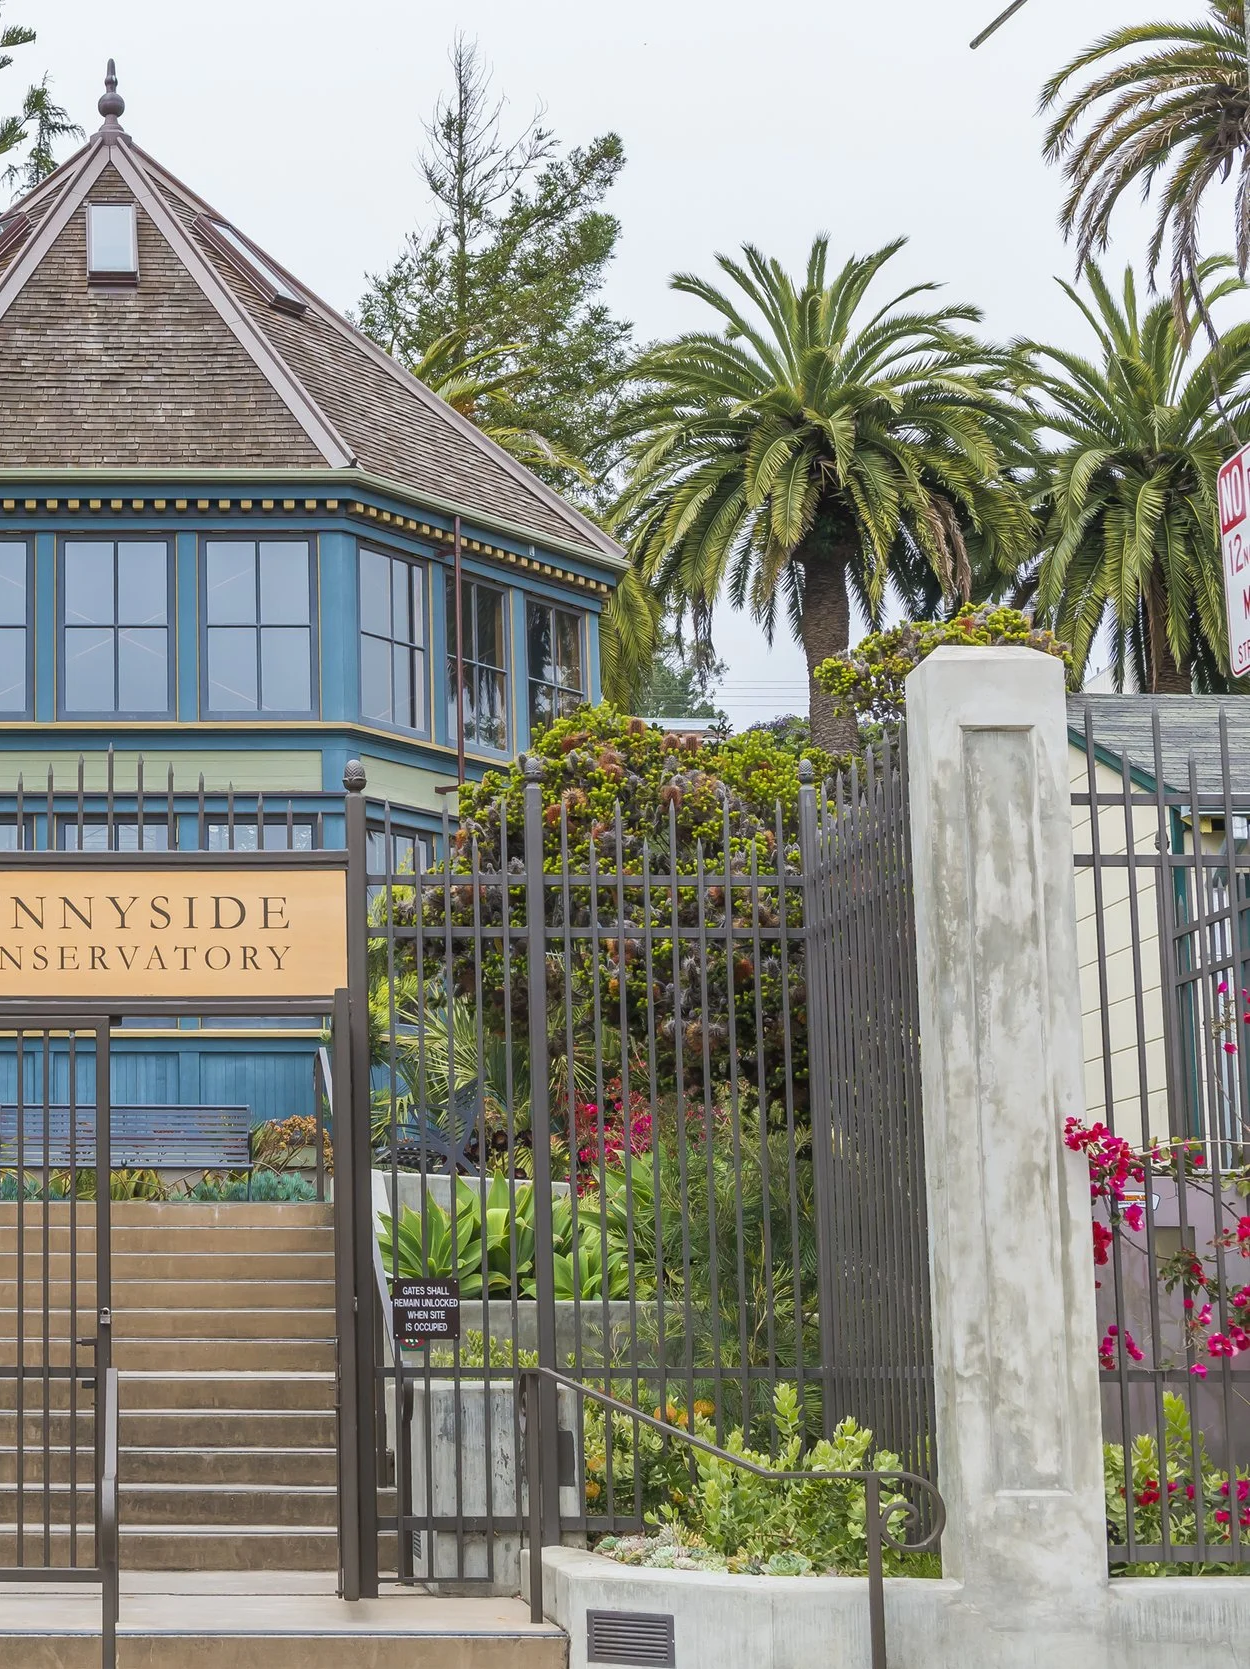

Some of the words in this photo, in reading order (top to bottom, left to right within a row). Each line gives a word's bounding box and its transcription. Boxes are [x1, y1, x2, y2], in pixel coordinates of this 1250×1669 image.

[1220, 465, 1242, 526] NO
[402, 1286, 425, 1295] GATES
[426, 1286, 450, 1295] SHALL
[394, 1298, 420, 1307] REMAIN
[421, 1298, 458, 1307] UNLOCKED
[407, 1310, 428, 1319] WHEN
[430, 1310, 445, 1319] SITE
[405, 1322, 413, 1332] IS
[414, 1322, 448, 1332] OCCUPIED
